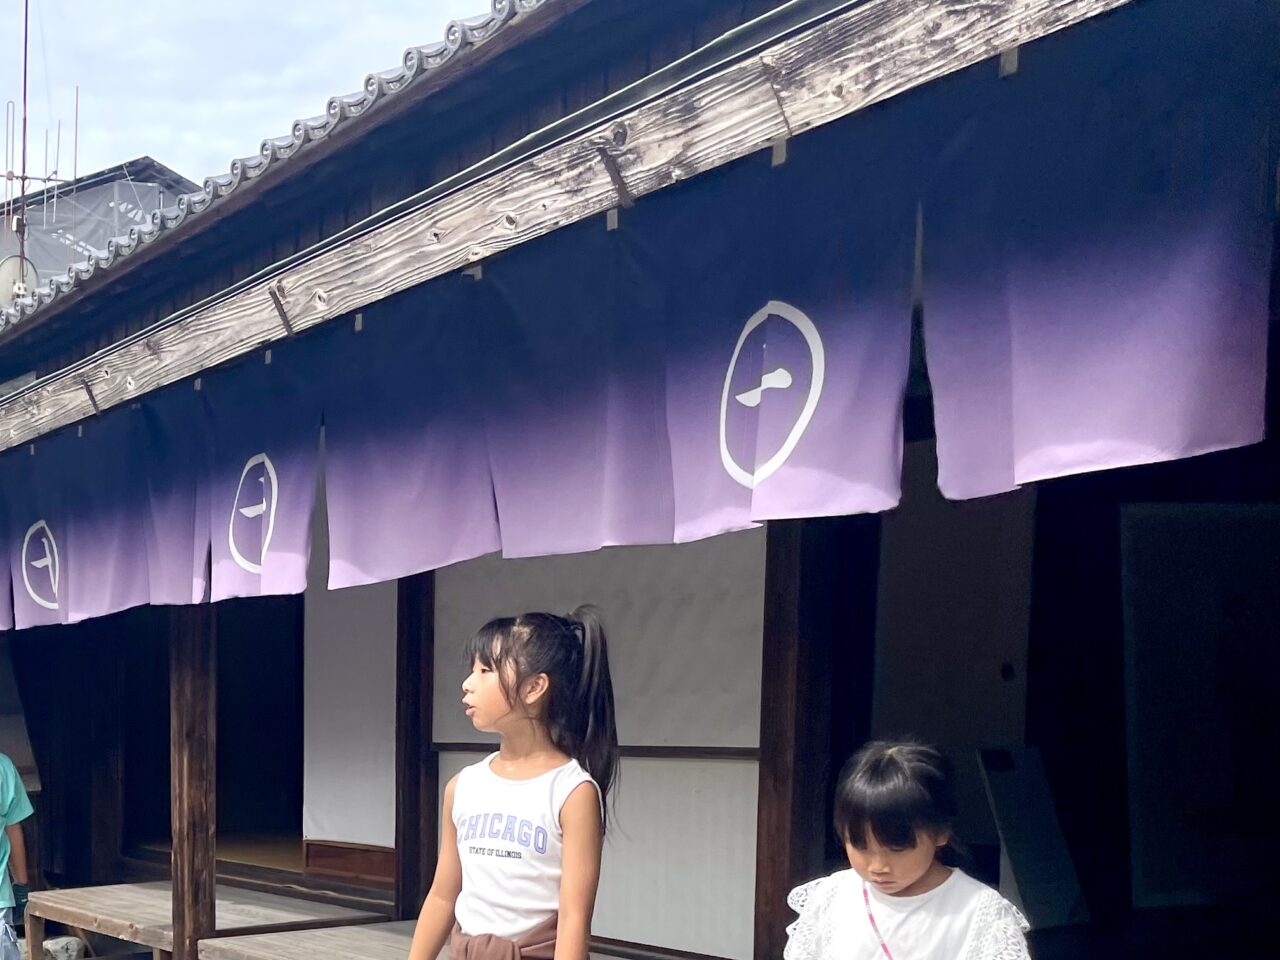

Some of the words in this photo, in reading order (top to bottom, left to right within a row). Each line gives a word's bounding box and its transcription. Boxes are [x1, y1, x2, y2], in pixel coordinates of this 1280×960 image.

[457, 812, 549, 855] CHICAGO
[469, 846, 486, 856] STATE
[487, 848, 494, 857] OF
[495, 848, 523, 860] ILLINOIS
